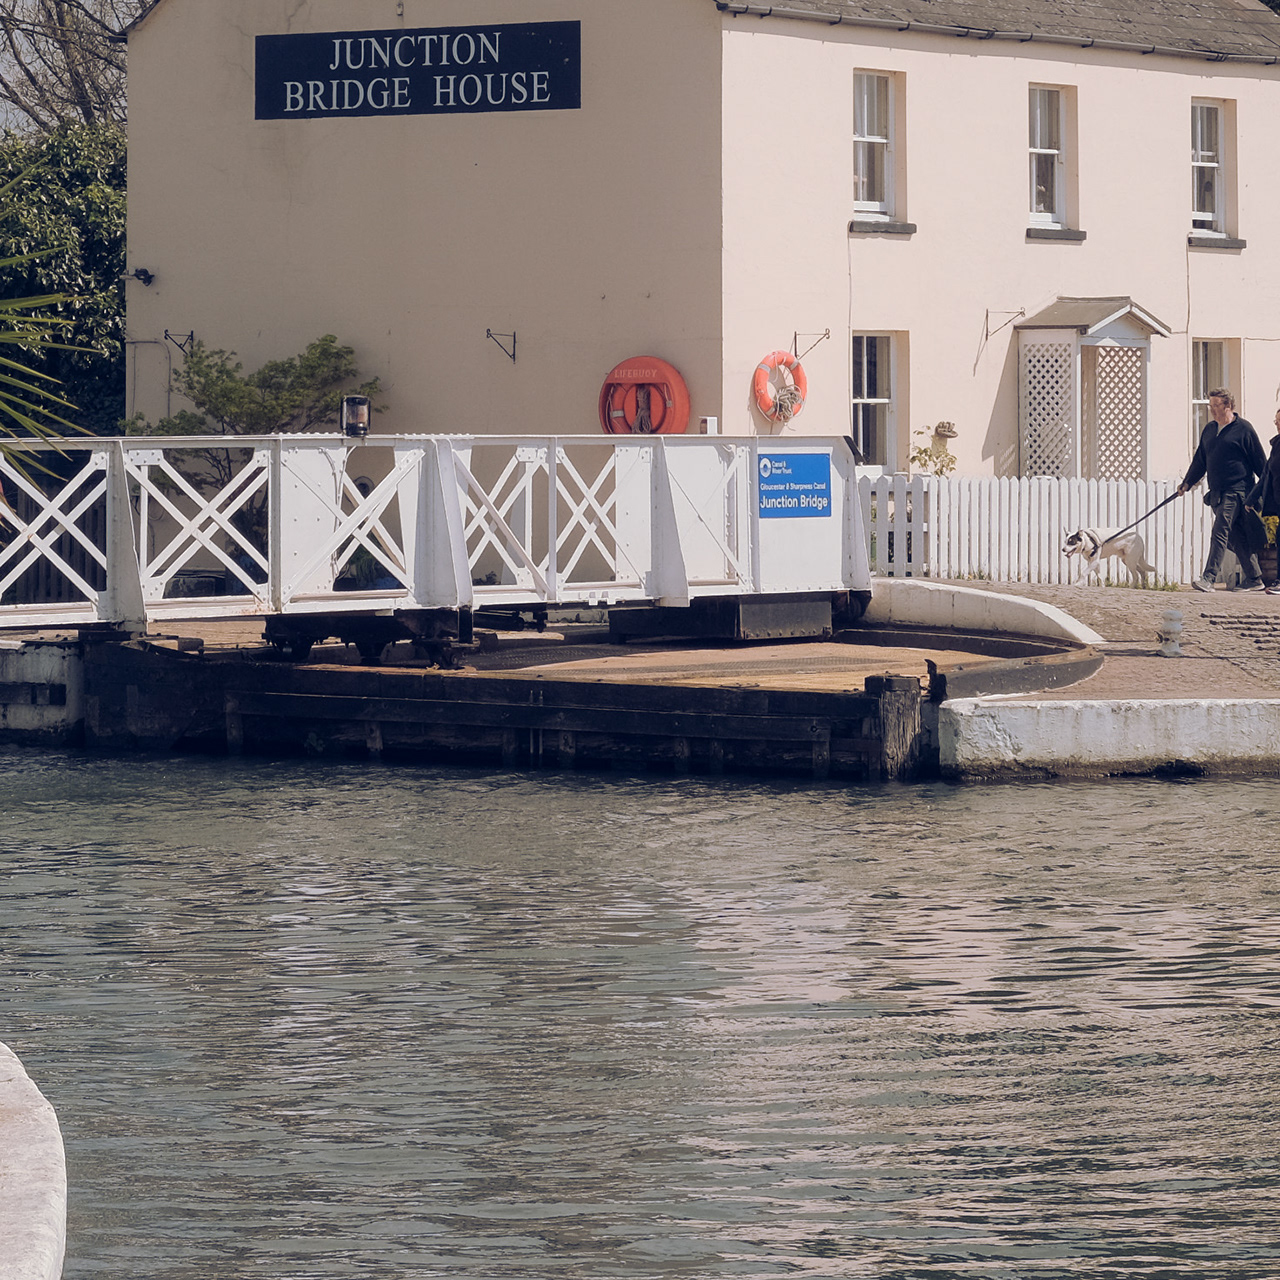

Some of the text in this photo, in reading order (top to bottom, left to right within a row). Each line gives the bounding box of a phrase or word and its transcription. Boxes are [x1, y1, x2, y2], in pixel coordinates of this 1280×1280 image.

[329, 32, 502, 70] JUNCTION
[283, 71, 551, 112] BRIDGE HOUSE
[614, 369, 657, 378] LIFEBUOY
[790, 483, 812, 491] Sharpness
[813, 482, 826, 490] Canal
[760, 494, 828, 510] Junction Bridge
